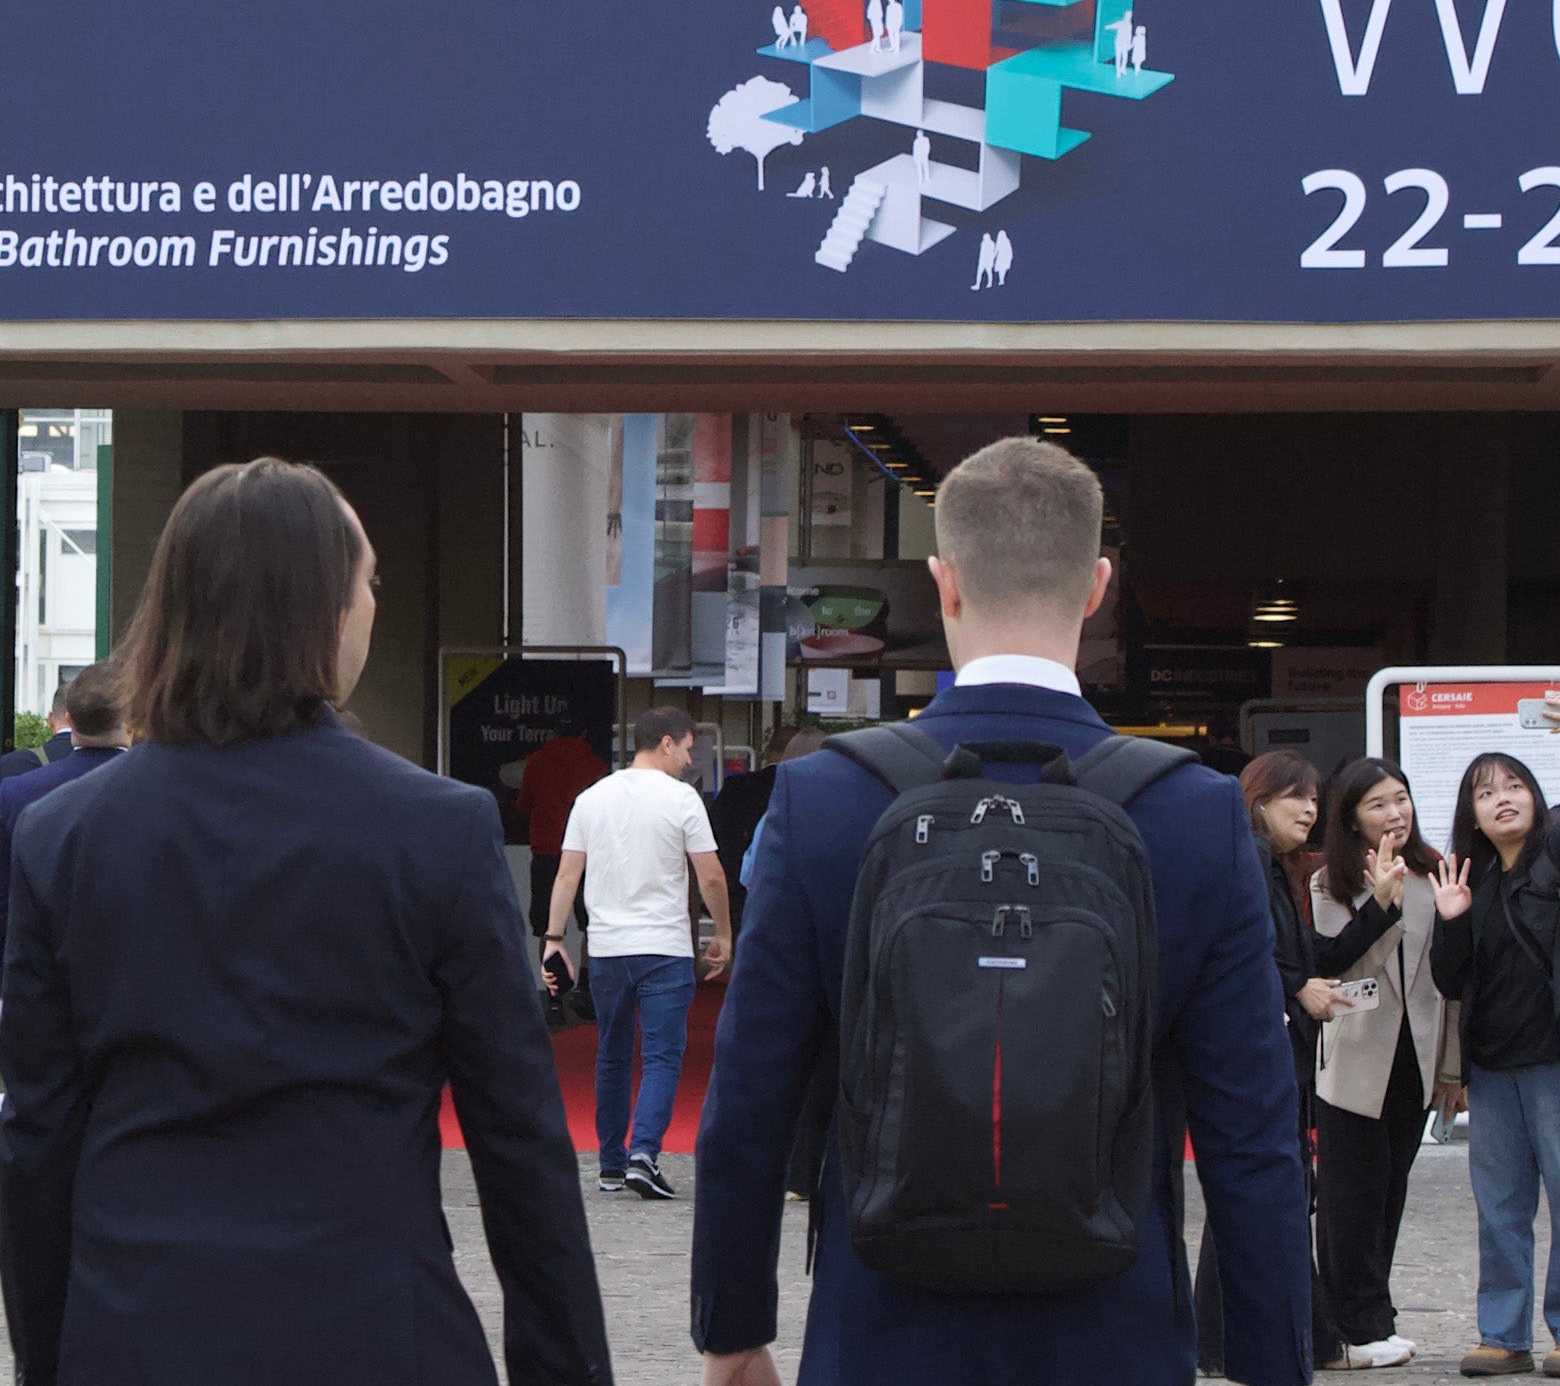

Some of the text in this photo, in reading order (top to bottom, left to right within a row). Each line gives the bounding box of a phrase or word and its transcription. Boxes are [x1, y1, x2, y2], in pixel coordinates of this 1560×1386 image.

[194, 182, 215, 212] e
[228, 173, 580, 217] dell'Arredobagno
[209, 227, 449, 272] Furnishings
[1432, 692, 1473, 702] CERSAIE
